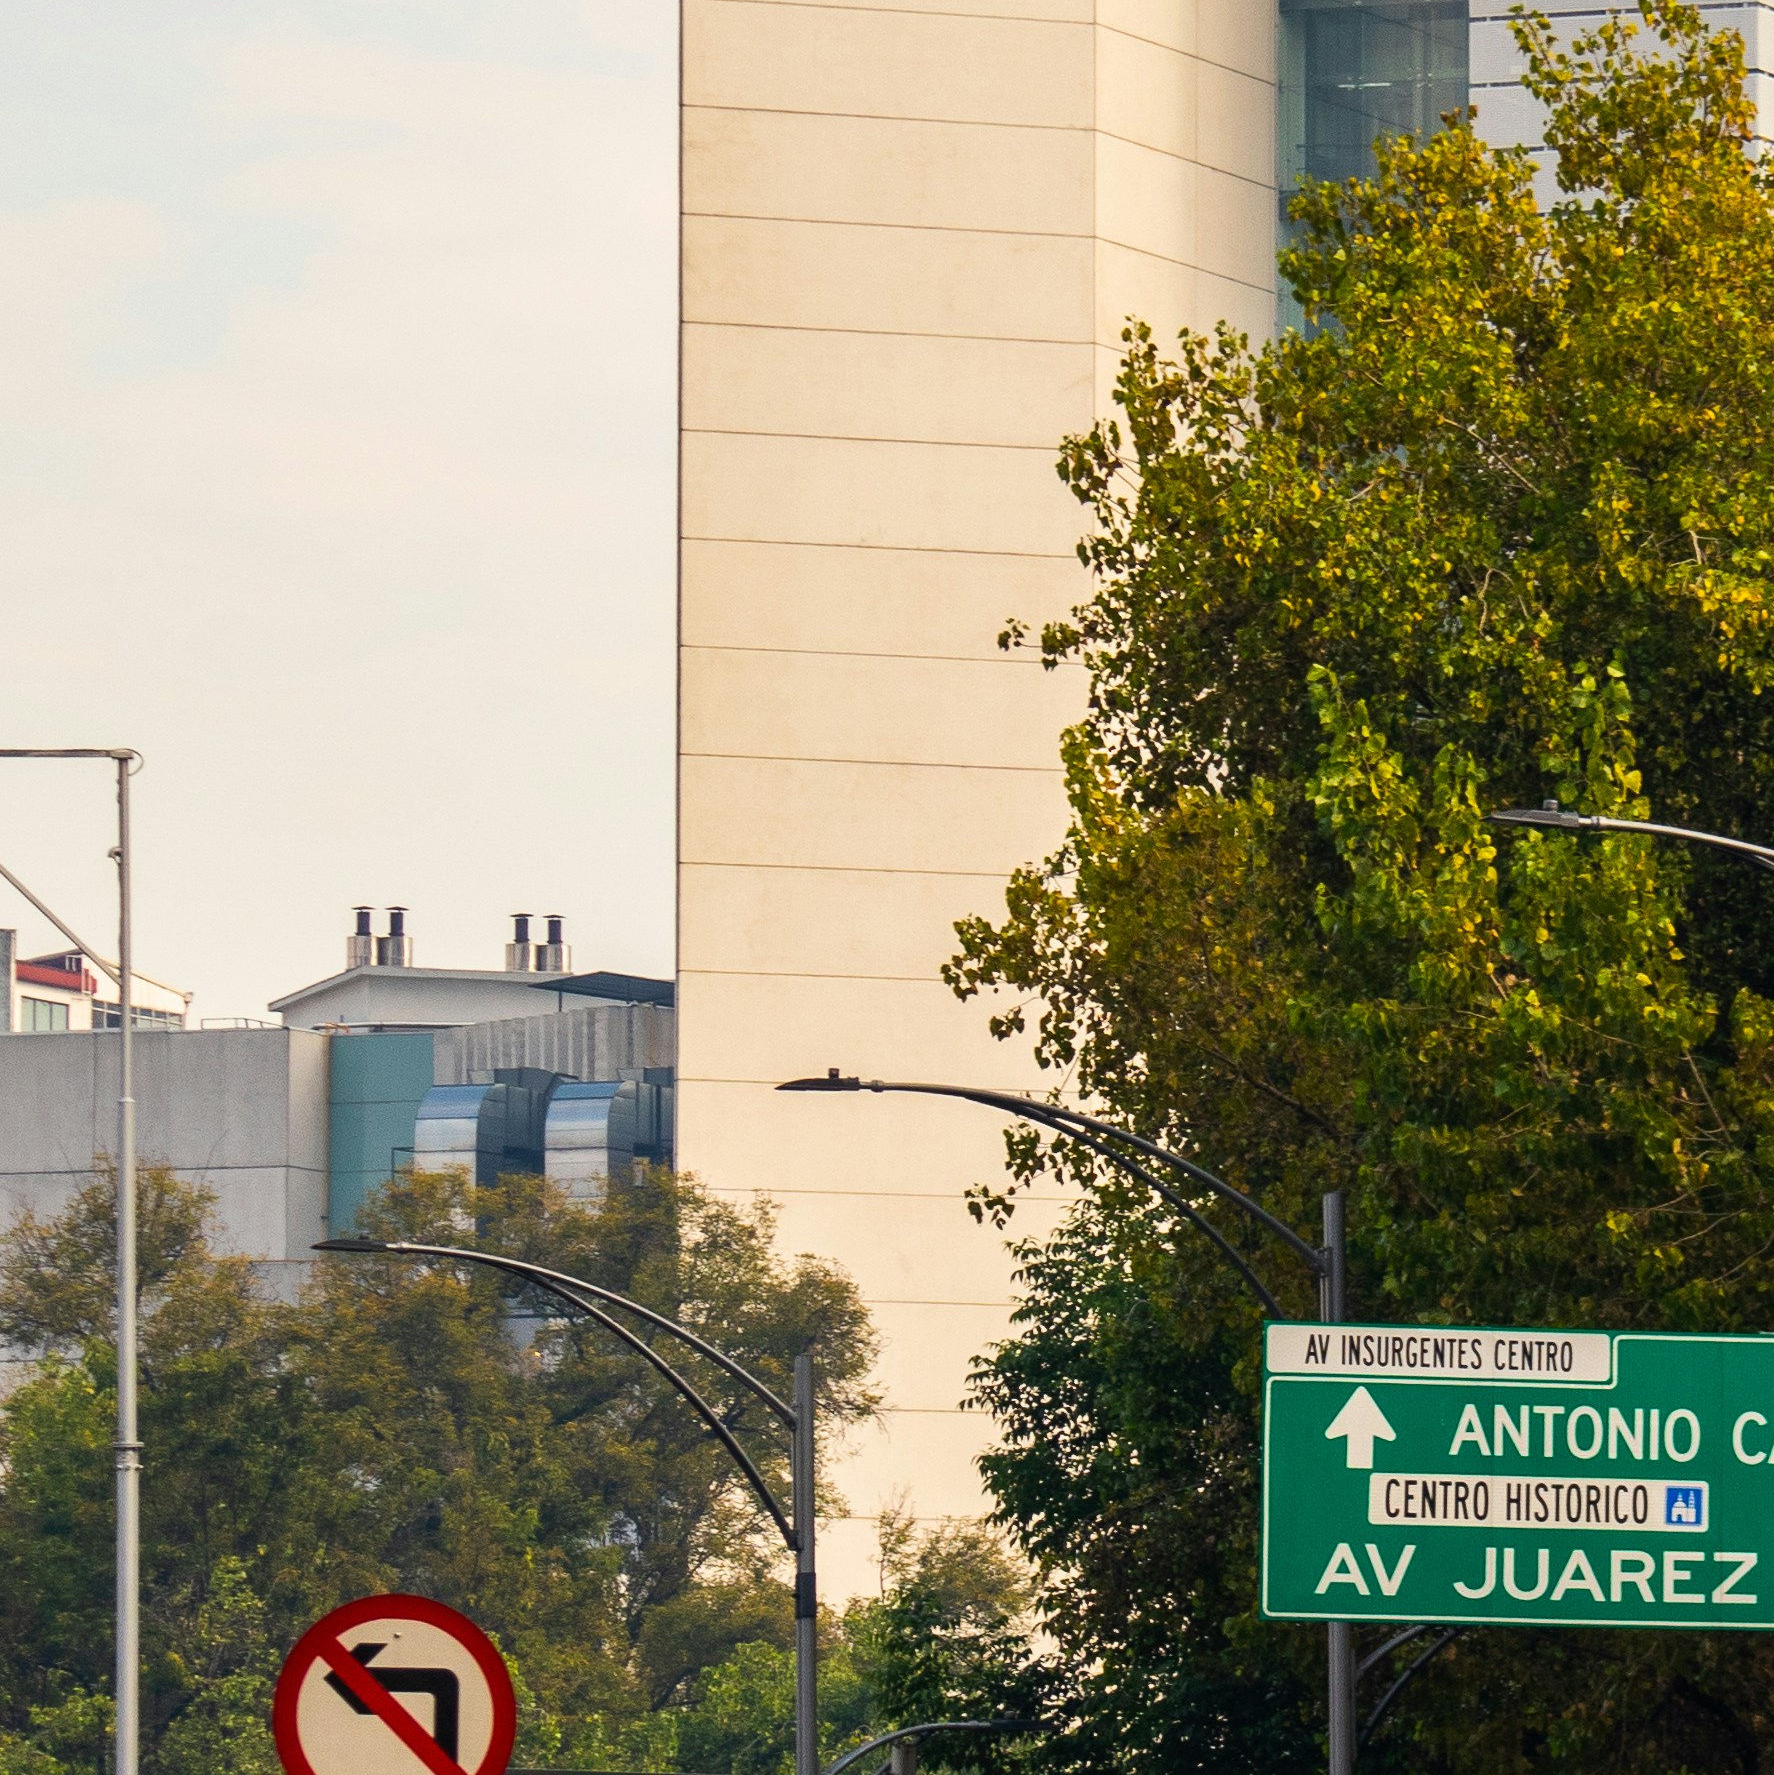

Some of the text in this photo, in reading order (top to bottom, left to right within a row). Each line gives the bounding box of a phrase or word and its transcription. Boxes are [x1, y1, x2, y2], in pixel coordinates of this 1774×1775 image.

[1304, 1334, 1573, 1372] AV INSURGENTES CENTRO
[1448, 1403, 1701, 1463] ANTONIO
[1384, 1479, 1649, 1525] CENTRO HISTORICO
[1314, 1542, 1758, 1605] AV JUAREZ
